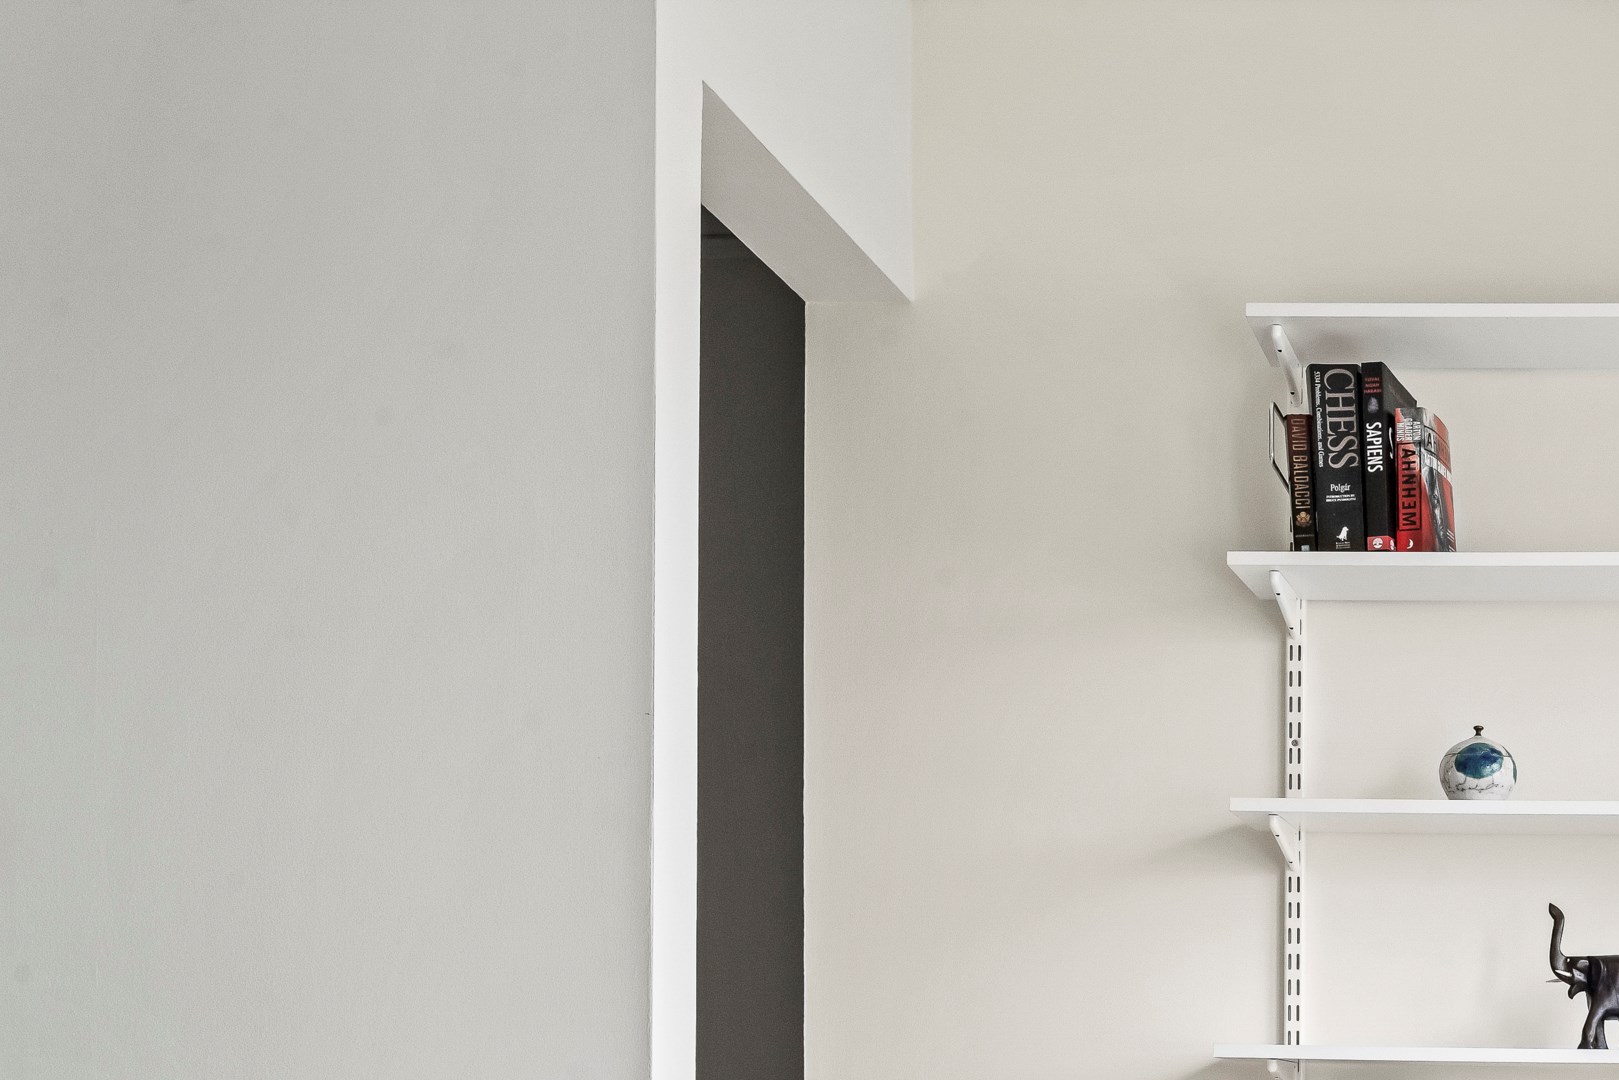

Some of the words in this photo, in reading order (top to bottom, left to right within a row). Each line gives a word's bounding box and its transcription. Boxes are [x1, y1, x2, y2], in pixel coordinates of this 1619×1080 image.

[1290, 418, 1307, 451] DAVID
[1324, 368, 1360, 469] CHESS
[1396, 422, 1405, 442] MINUS
[1404, 417, 1413, 441] GRADER
[1413, 421, 1421, 441] ARTON
[1366, 421, 1384, 473] SAPIENS
[1293, 455, 1311, 509] BALDACCI
[1330, 483, 1351, 493] Polgár
[1402, 448, 1417, 527] AHNHEM
